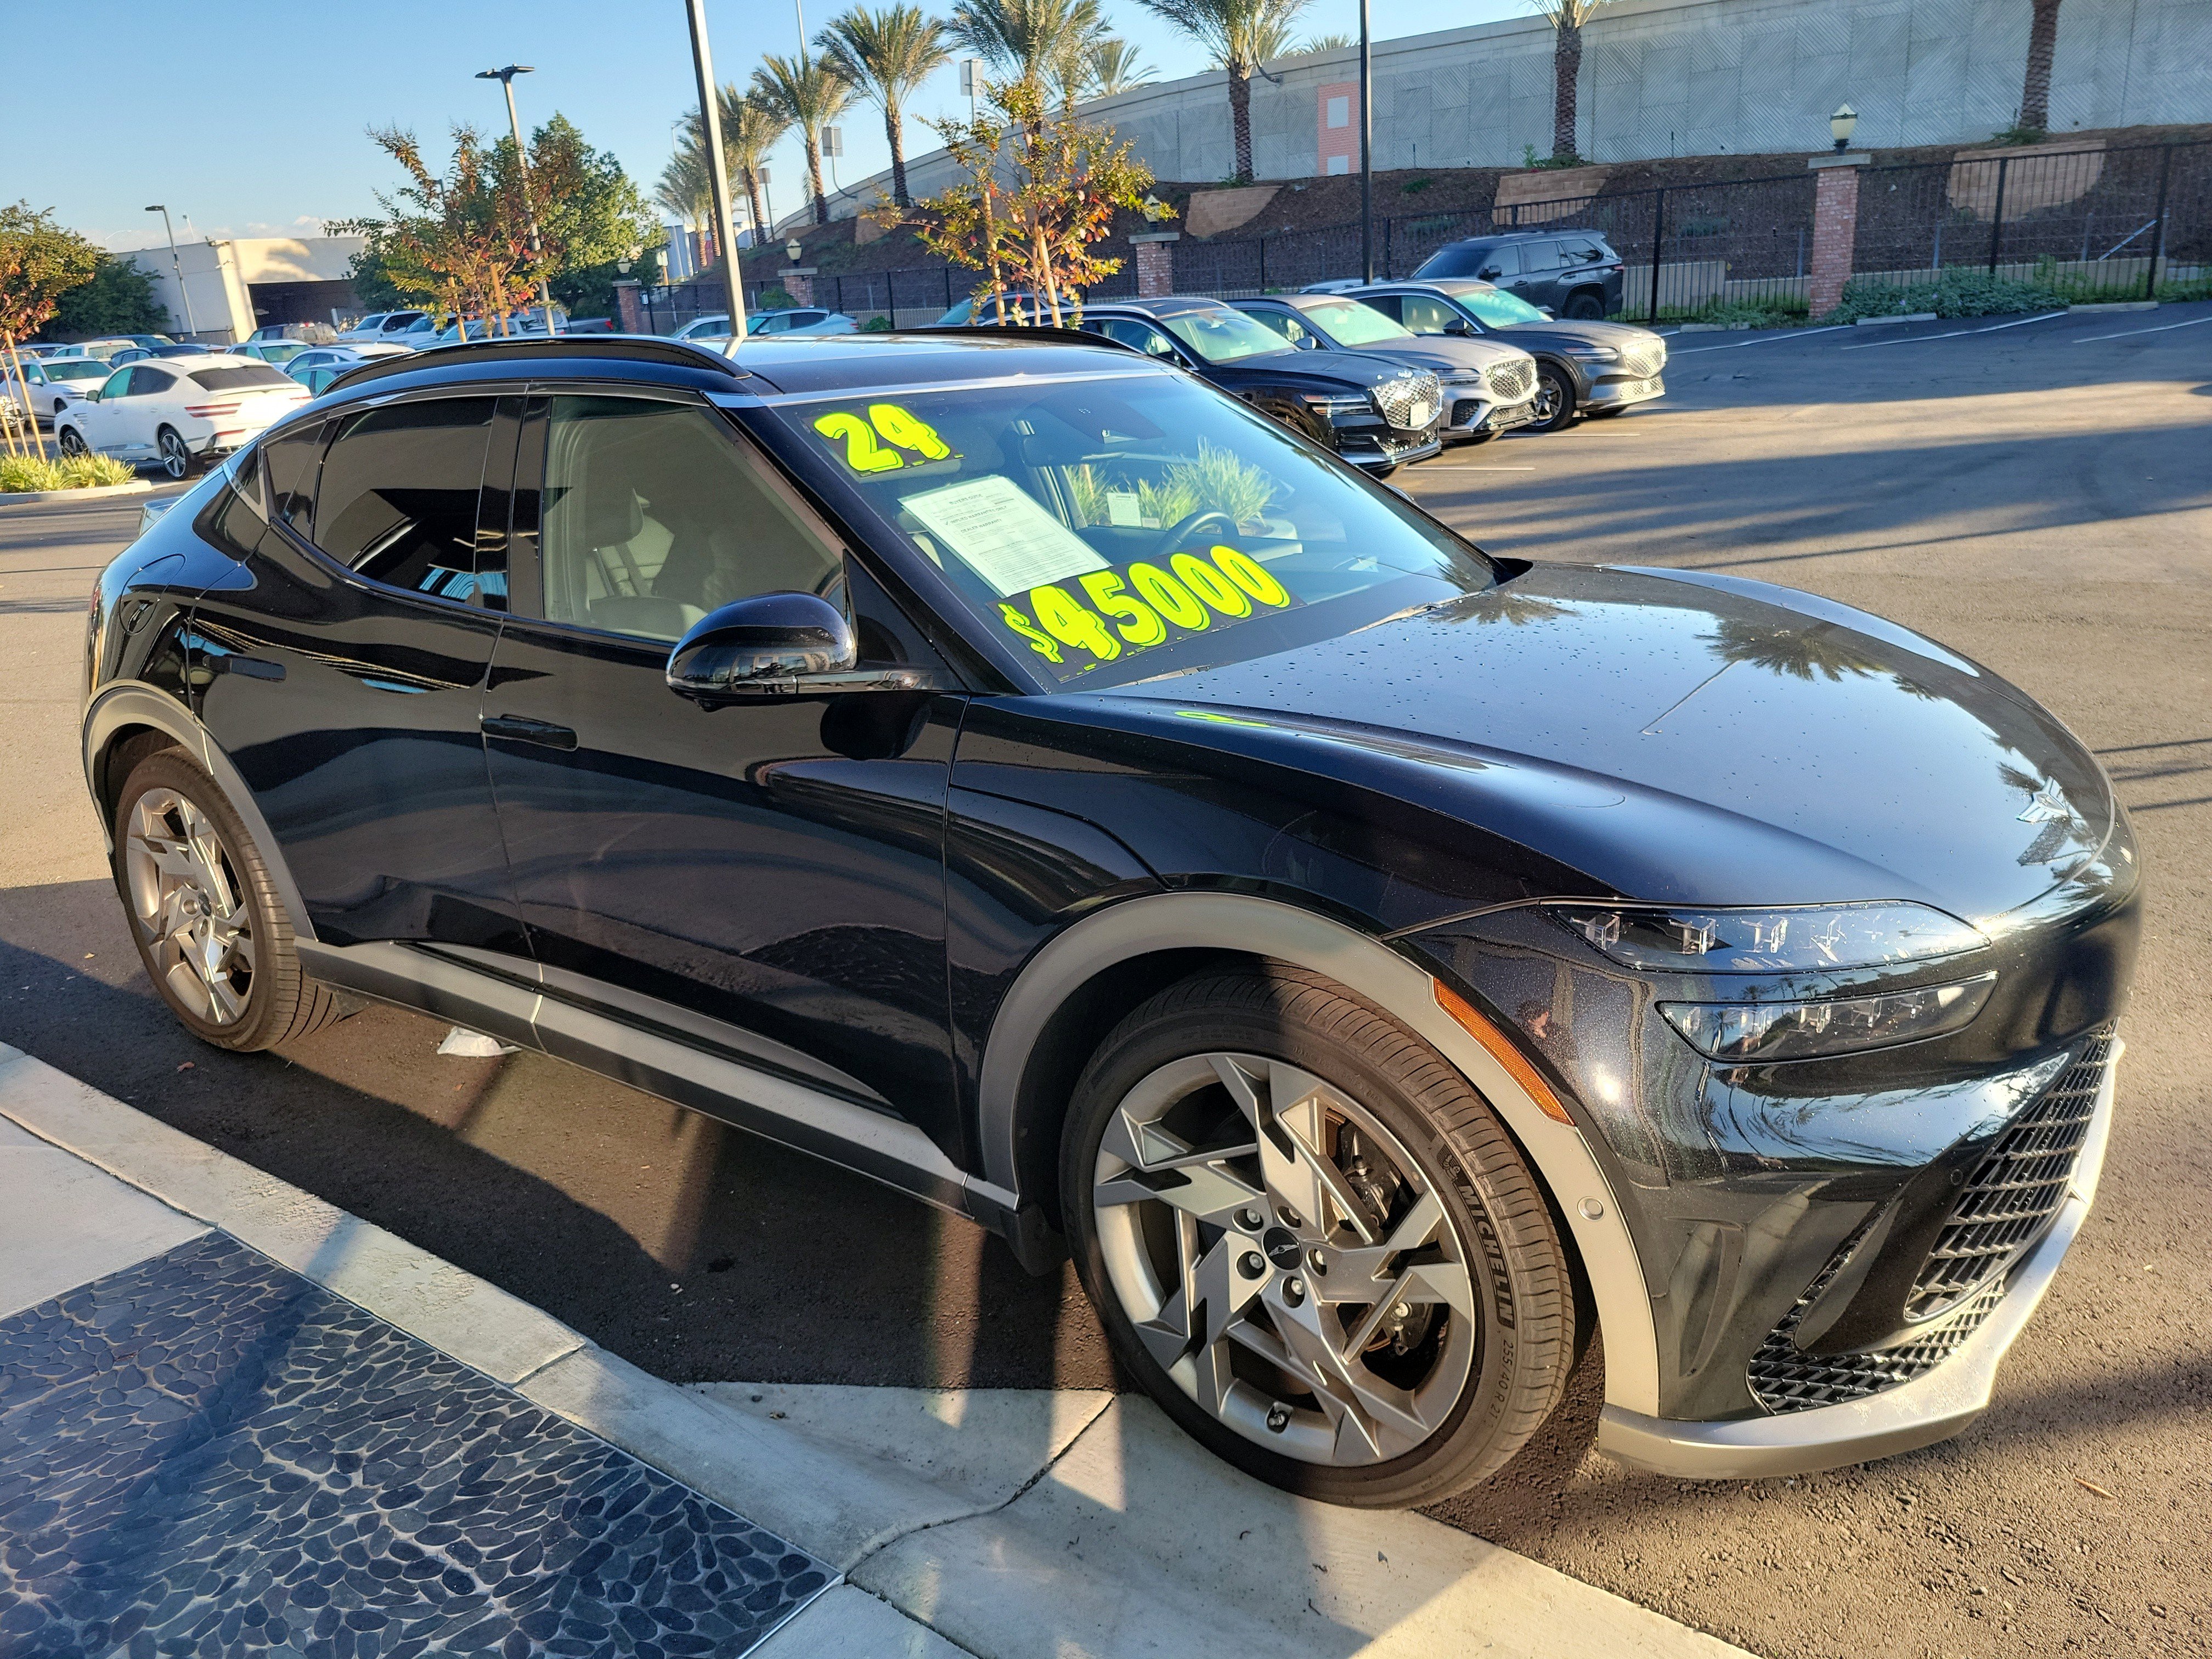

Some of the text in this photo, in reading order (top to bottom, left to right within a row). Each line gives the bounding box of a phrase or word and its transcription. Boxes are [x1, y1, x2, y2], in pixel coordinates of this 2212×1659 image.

[814, 403, 951, 473] 24
[961, 525, 978, 533] DEALER
[998, 545, 1291, 664] $45000
[1458, 1185, 1514, 1322] MICHELIN
[1489, 1339, 1514, 1419] 255/40 R 21
